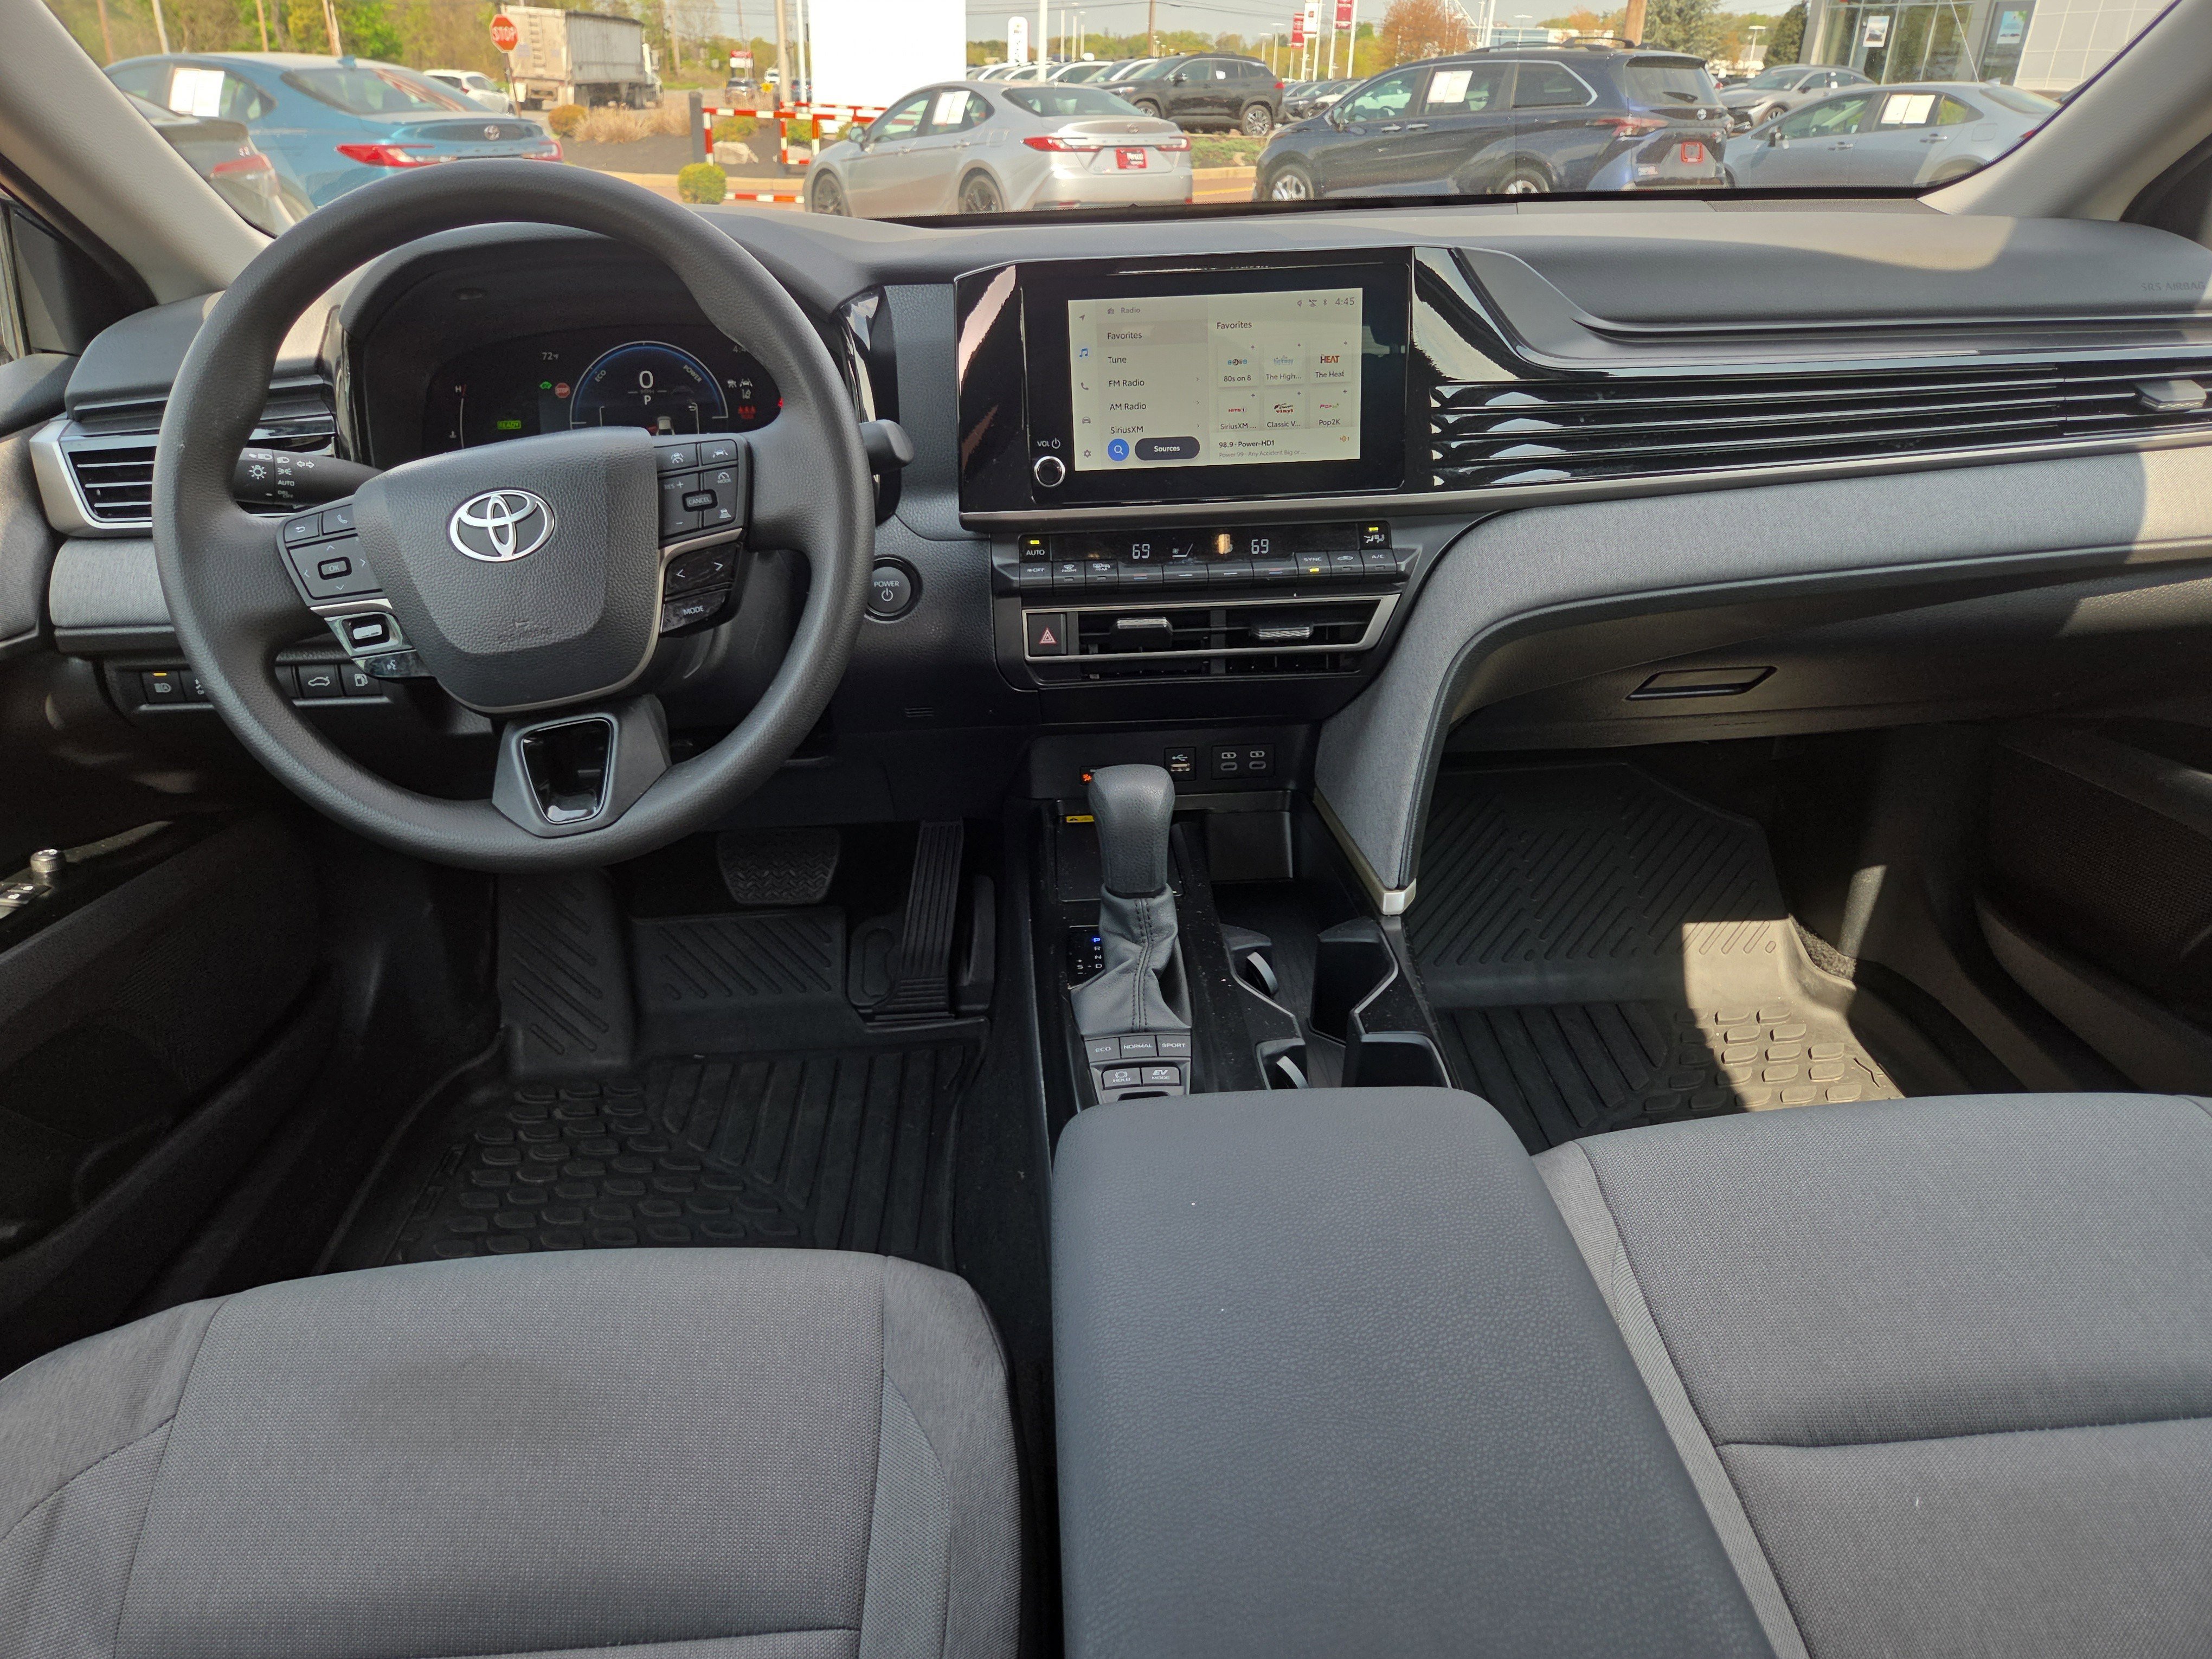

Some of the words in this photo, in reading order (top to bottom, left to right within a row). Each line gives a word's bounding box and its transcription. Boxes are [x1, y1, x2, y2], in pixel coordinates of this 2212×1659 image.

[492, 26, 517, 42] STOP
[2166, 281, 2205, 292] AIRBAG
[1335, 297, 1355, 306] 4:45
[1217, 321, 1252, 329] Favorites
[1107, 331, 1142, 340] Favorites
[1320, 355, 1340, 364] HEAT
[595, 369, 606, 382] ECO
[683, 364, 702, 383] POWER
[639, 370, 654, 389] 0
[1122, 379, 1145, 387] Radio
[455, 385, 461, 393] H
[644, 395, 651, 405] P
[1124, 402, 1147, 410] Radio
[1110, 426, 1144, 434] SiriusXM
[1238, 440, 1274, 448] Power-HD1
[1154, 445, 1181, 453] Sources
[687, 497, 710, 506] CANCEL
[1251, 538, 1269, 555] 69
[1132, 544, 1150, 560] 69
[329, 564, 339, 573] OK
[683, 605, 705, 615] MODE
